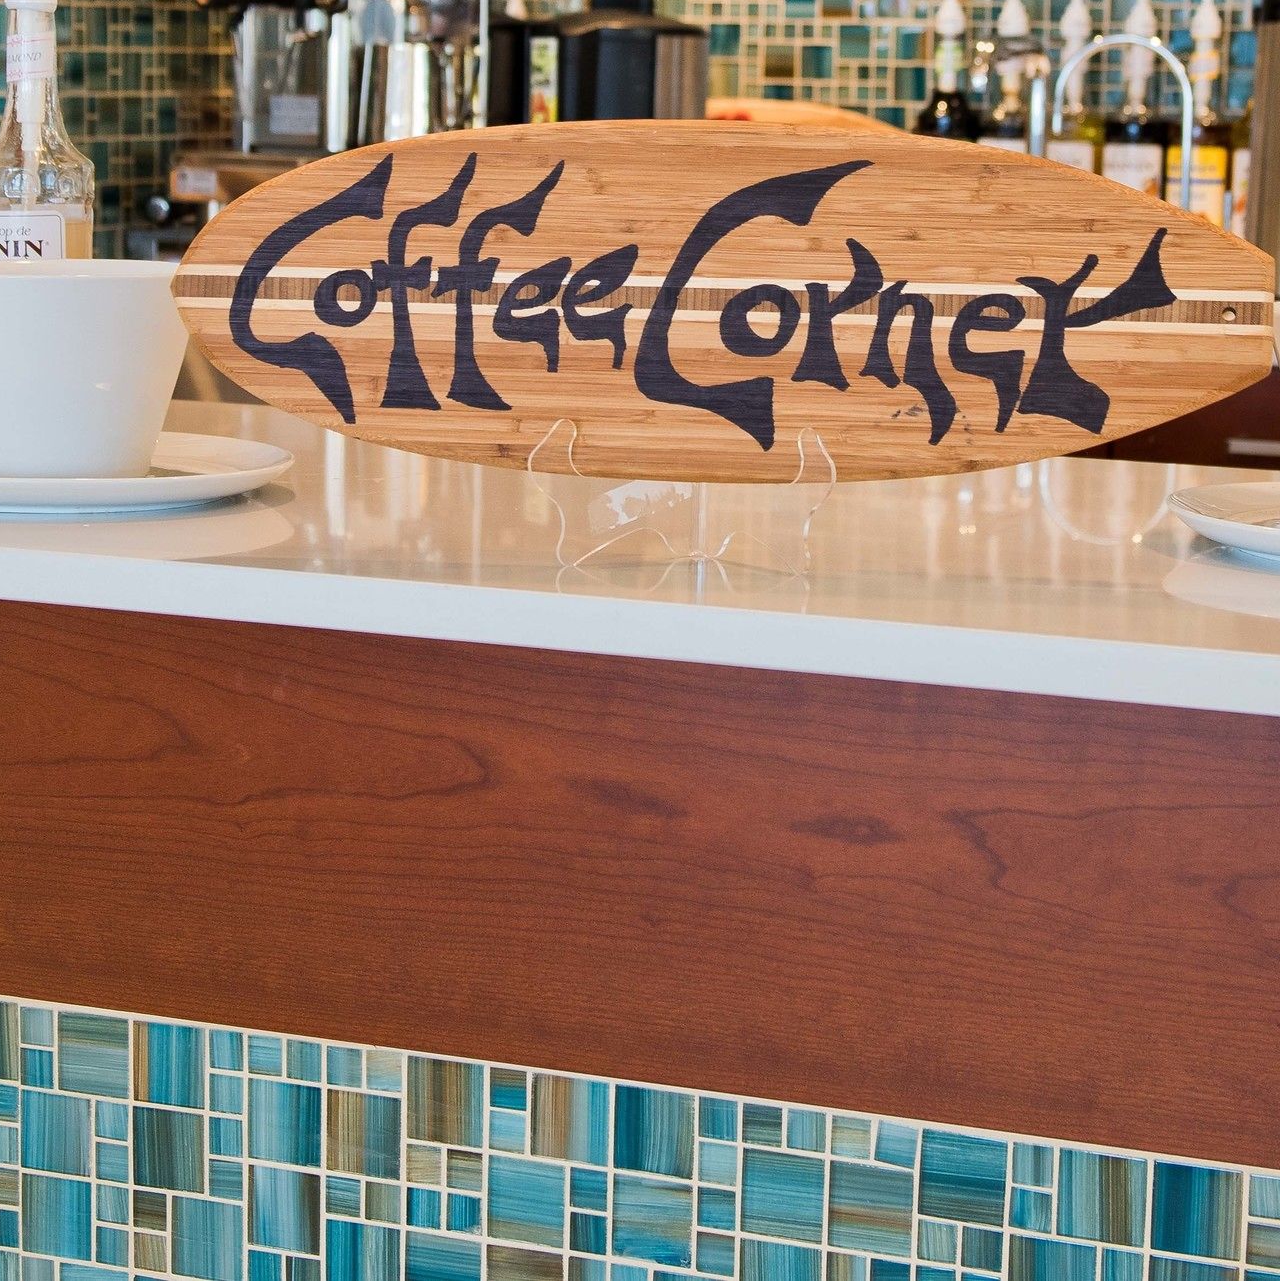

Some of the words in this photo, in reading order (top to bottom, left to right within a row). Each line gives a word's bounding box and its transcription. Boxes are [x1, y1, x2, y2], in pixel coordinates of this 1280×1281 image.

[16, 225, 32, 237] de
[228, 152, 639, 425] Coffee
[634, 159, 1177, 452] Corner
